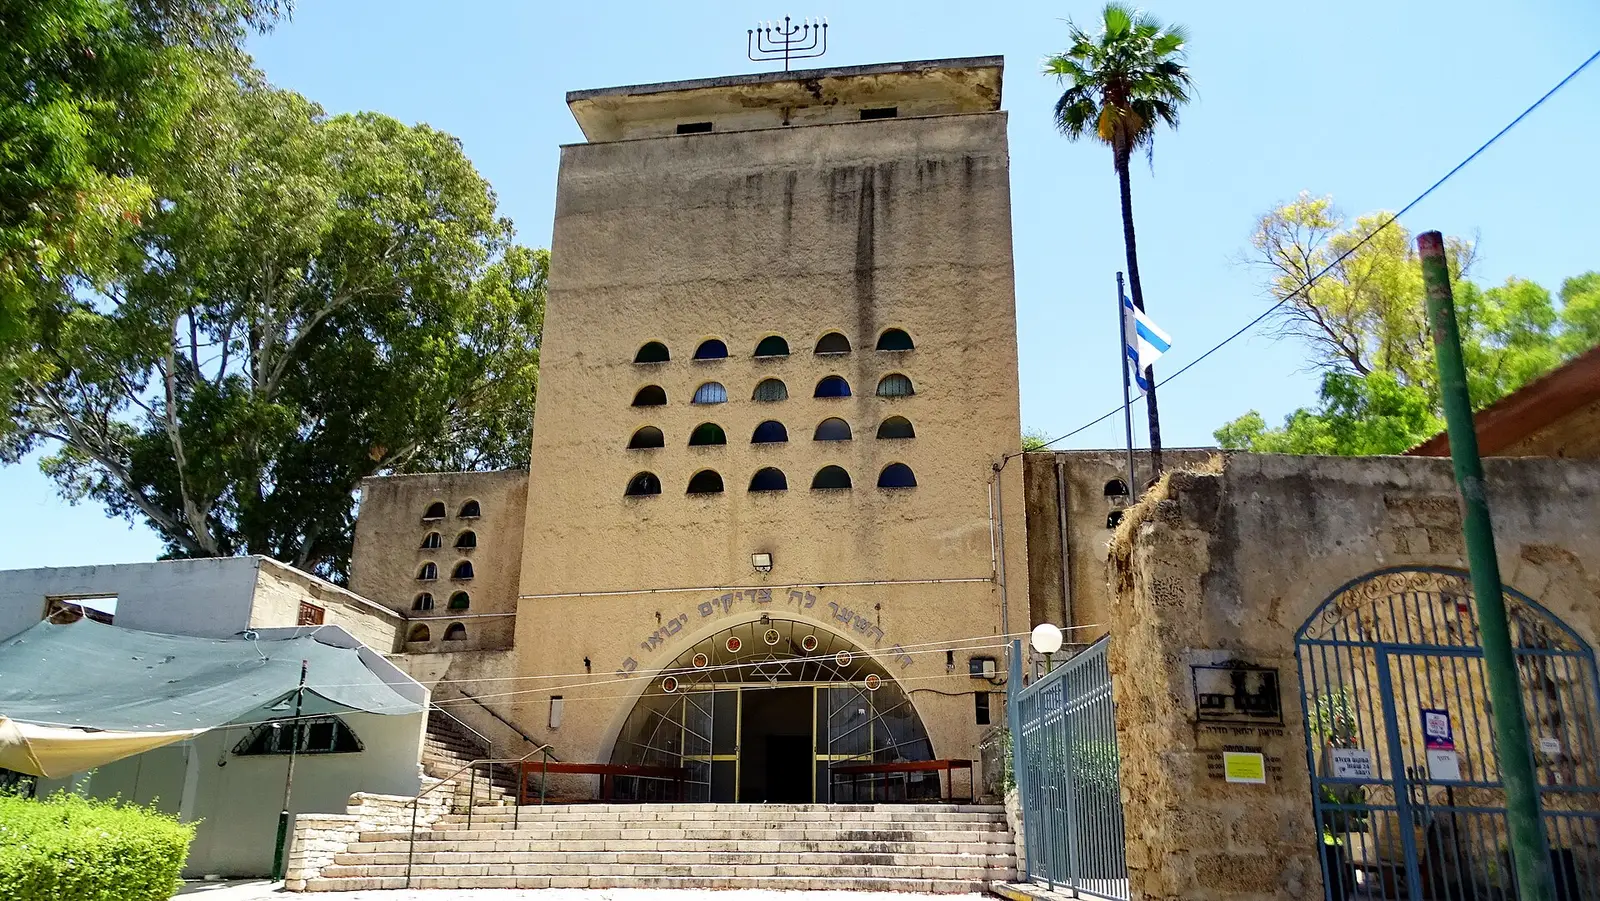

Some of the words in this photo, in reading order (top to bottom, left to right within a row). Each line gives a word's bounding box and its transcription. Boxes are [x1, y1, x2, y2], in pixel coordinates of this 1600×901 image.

[698, 588, 772, 617] צדיקים
[641, 613, 689, 652] יבואו
[828, 601, 885, 645] השער
[616, 656, 638, 679] בו
[887, 643, 914, 670] זה
